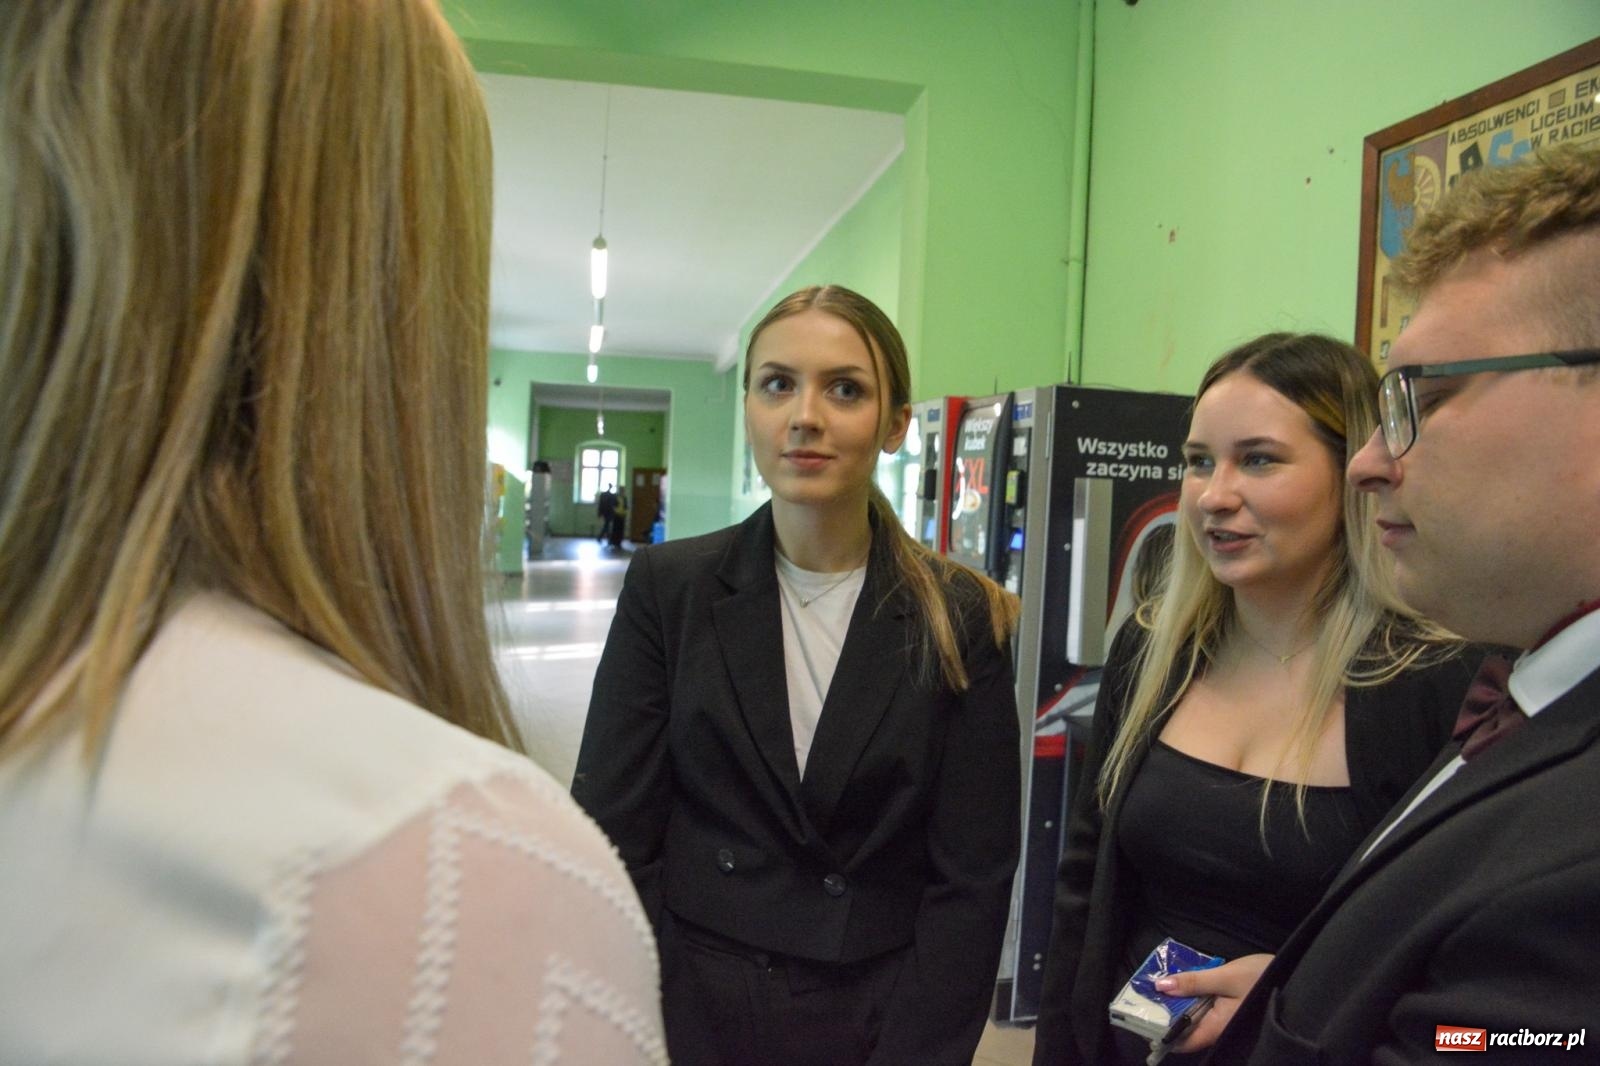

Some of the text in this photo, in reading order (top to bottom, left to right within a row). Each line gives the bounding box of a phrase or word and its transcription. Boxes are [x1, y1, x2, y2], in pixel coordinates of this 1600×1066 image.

[1450, 98, 1540, 146] ABSOLWENCI
[1531, 100, 1594, 133] LICEUM
[1077, 436, 1168, 460] Wszystko
[1086, 461, 1163, 482] zaczyna
